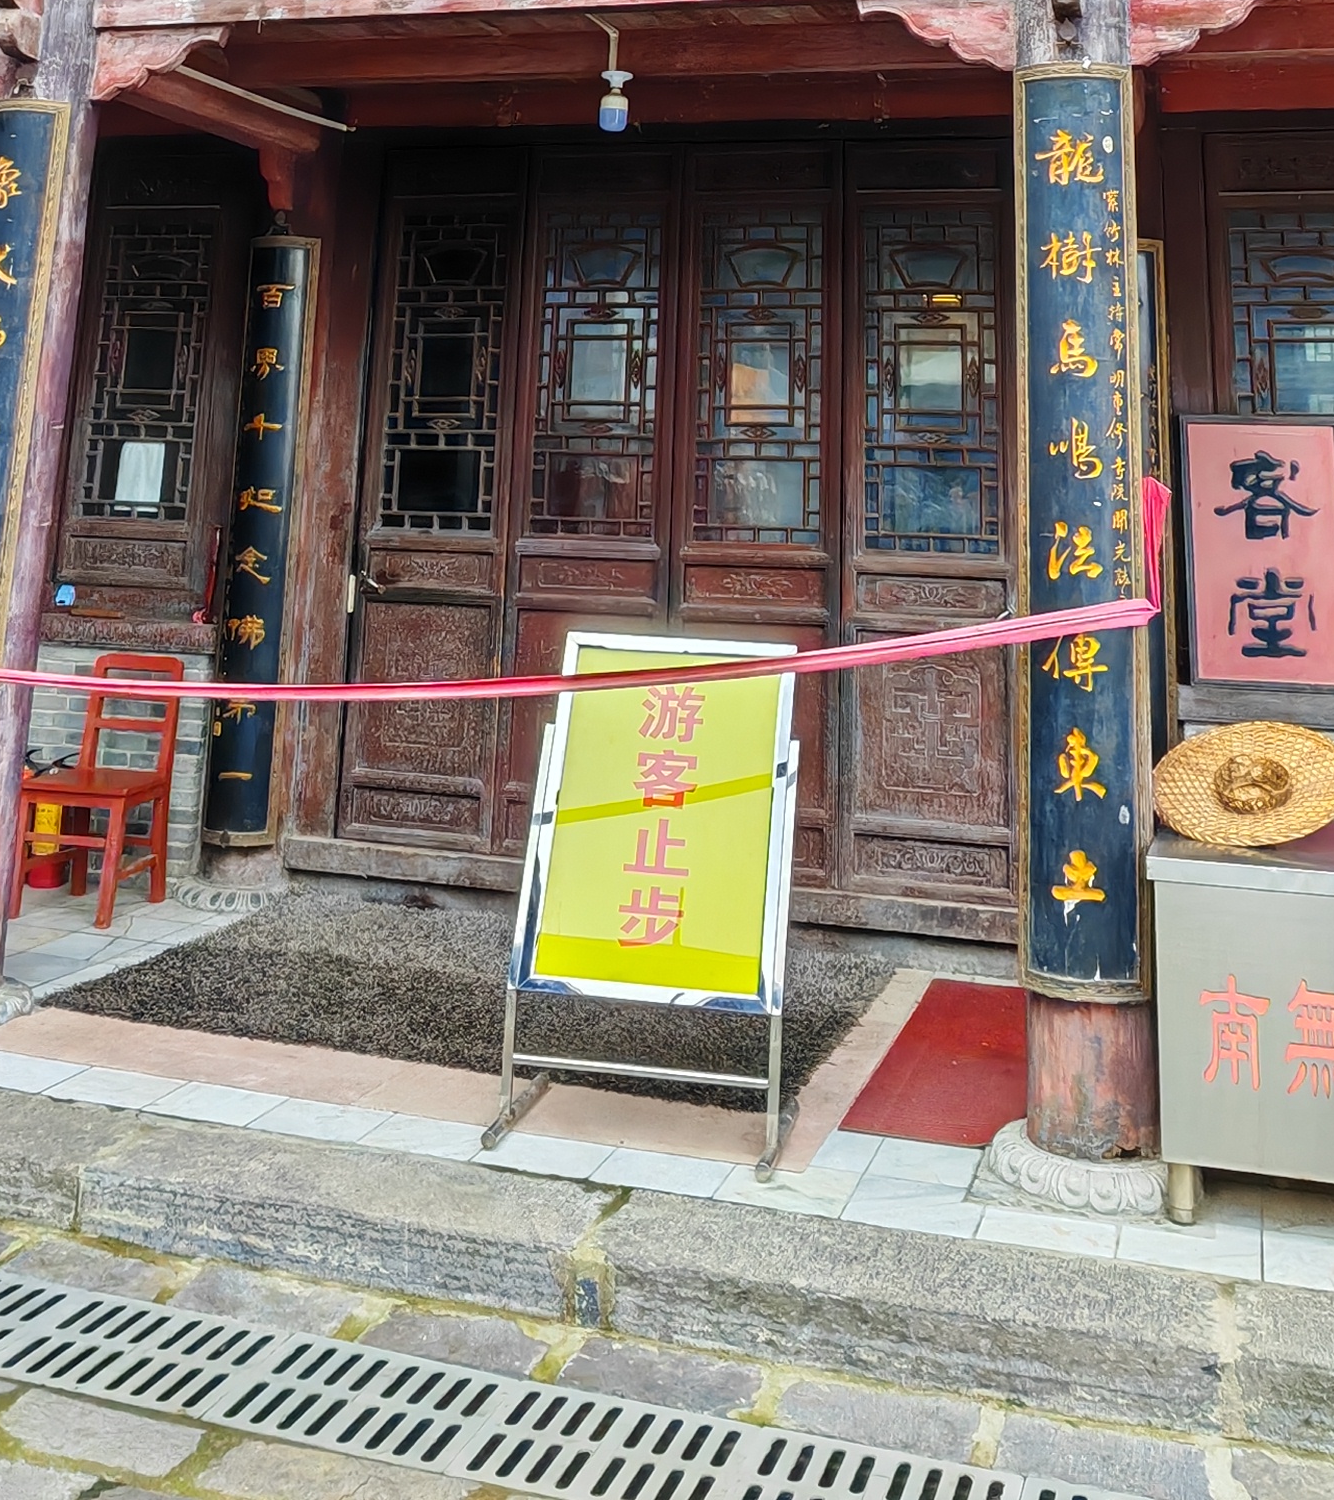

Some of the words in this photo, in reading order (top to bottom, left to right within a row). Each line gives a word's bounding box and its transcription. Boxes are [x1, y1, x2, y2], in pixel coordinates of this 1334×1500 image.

[1213, 449, 1320, 658] 客堂
[617, 684, 706, 948] 游客止步
